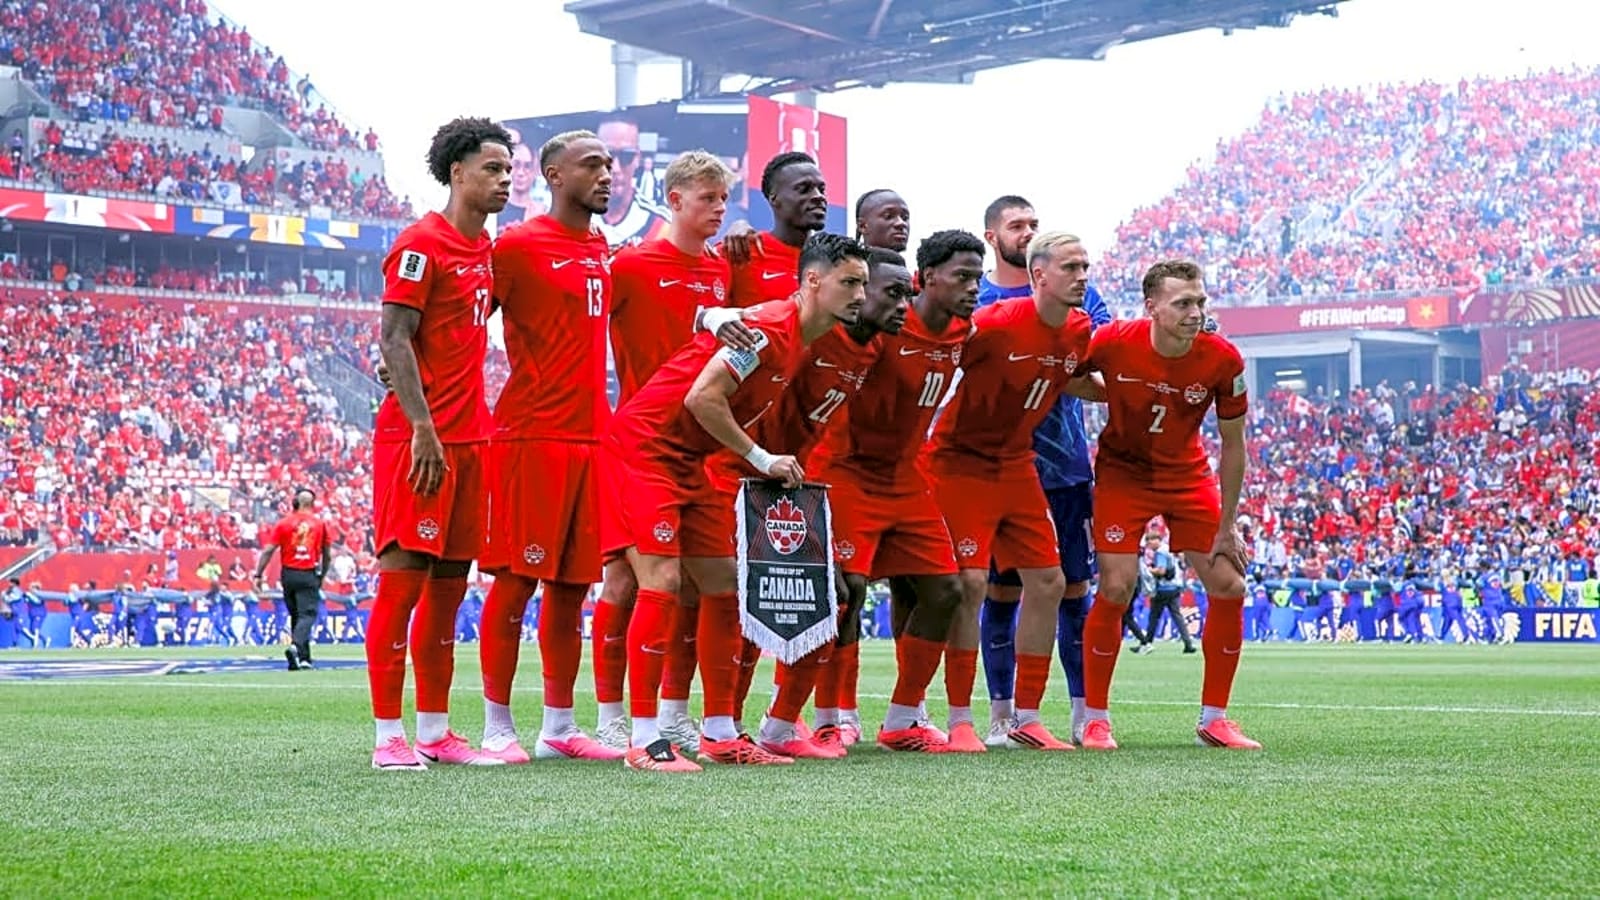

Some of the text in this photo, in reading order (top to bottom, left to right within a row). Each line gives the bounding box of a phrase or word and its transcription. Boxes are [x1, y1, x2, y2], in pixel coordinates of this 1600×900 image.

[473, 288, 489, 327] 17
[586, 278, 603, 317] 13
[1299, 305, 1406, 327] #FIFAWorldCup
[917, 371, 945, 407] 10
[1023, 378, 1052, 411] 11
[808, 388, 847, 424] 22
[1148, 404, 1167, 433] 2
[766, 521, 805, 531] CANADA
[759, 576, 816, 601] CANADA
[1535, 612, 1597, 638] FIFA
